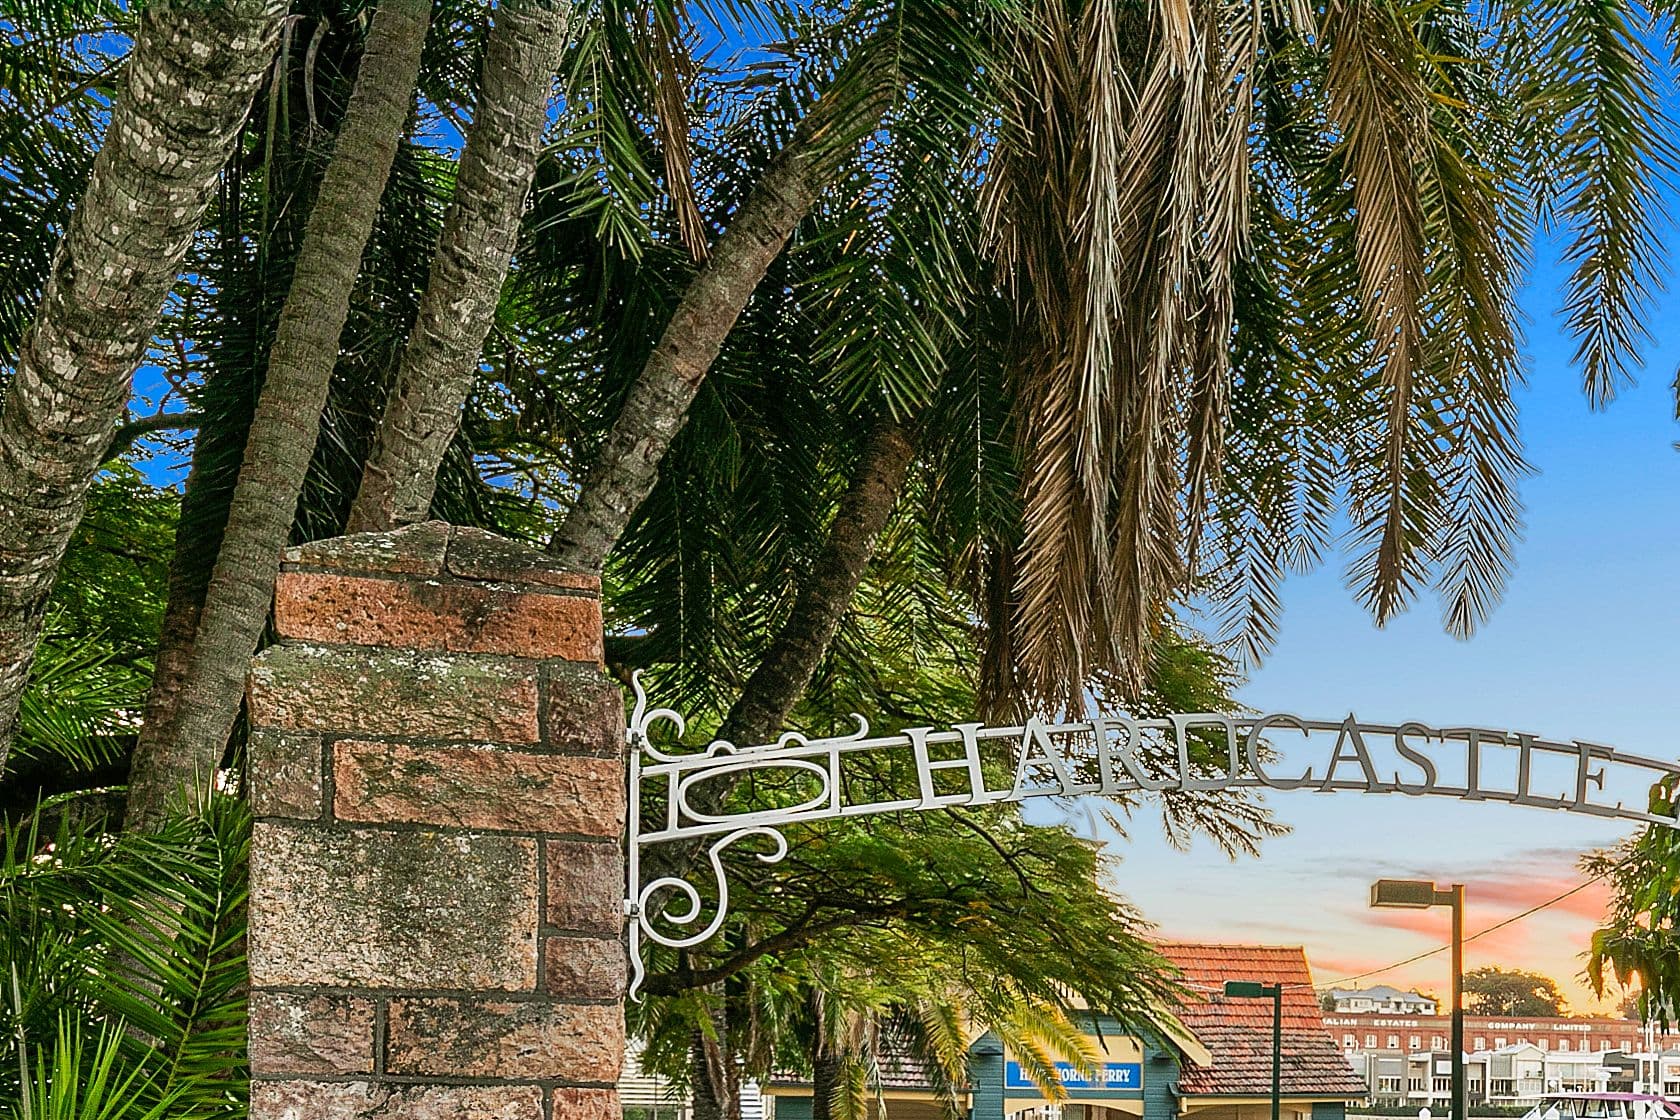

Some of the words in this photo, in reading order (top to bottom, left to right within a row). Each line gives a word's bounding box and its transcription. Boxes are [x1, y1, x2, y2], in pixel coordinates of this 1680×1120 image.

[902, 711, 1625, 819] HARDCASTLE
[1323, 1017, 1357, 1026] ALIAN
[1373, 1019, 1419, 1027] ESTATES
[1487, 1021, 1536, 1031] COMPANY
[1553, 1023, 1592, 1032] LIMITED
[1095, 1069, 1131, 1083] FERRY
